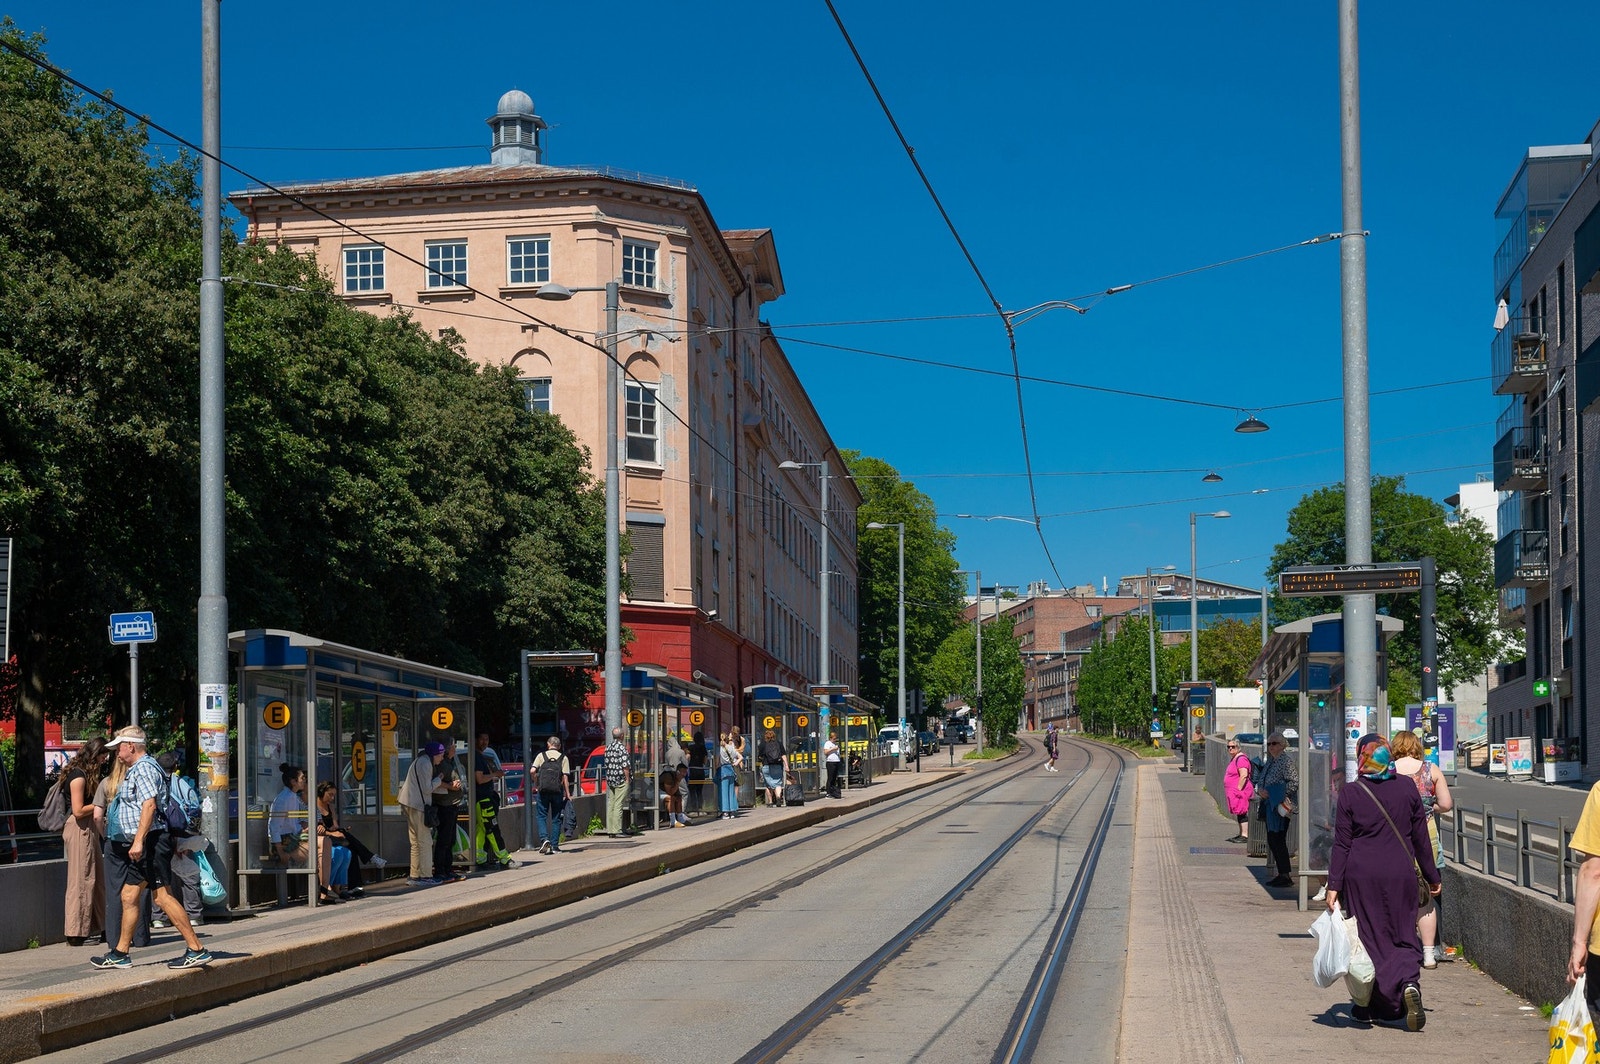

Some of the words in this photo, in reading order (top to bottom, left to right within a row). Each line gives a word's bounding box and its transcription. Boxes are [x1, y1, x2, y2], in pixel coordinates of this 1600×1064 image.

[272, 707, 282, 723] E
[438, 711, 446, 725] E
[632, 713, 638, 724] E
[694, 714, 700, 722] E
[766, 718, 772, 726] F
